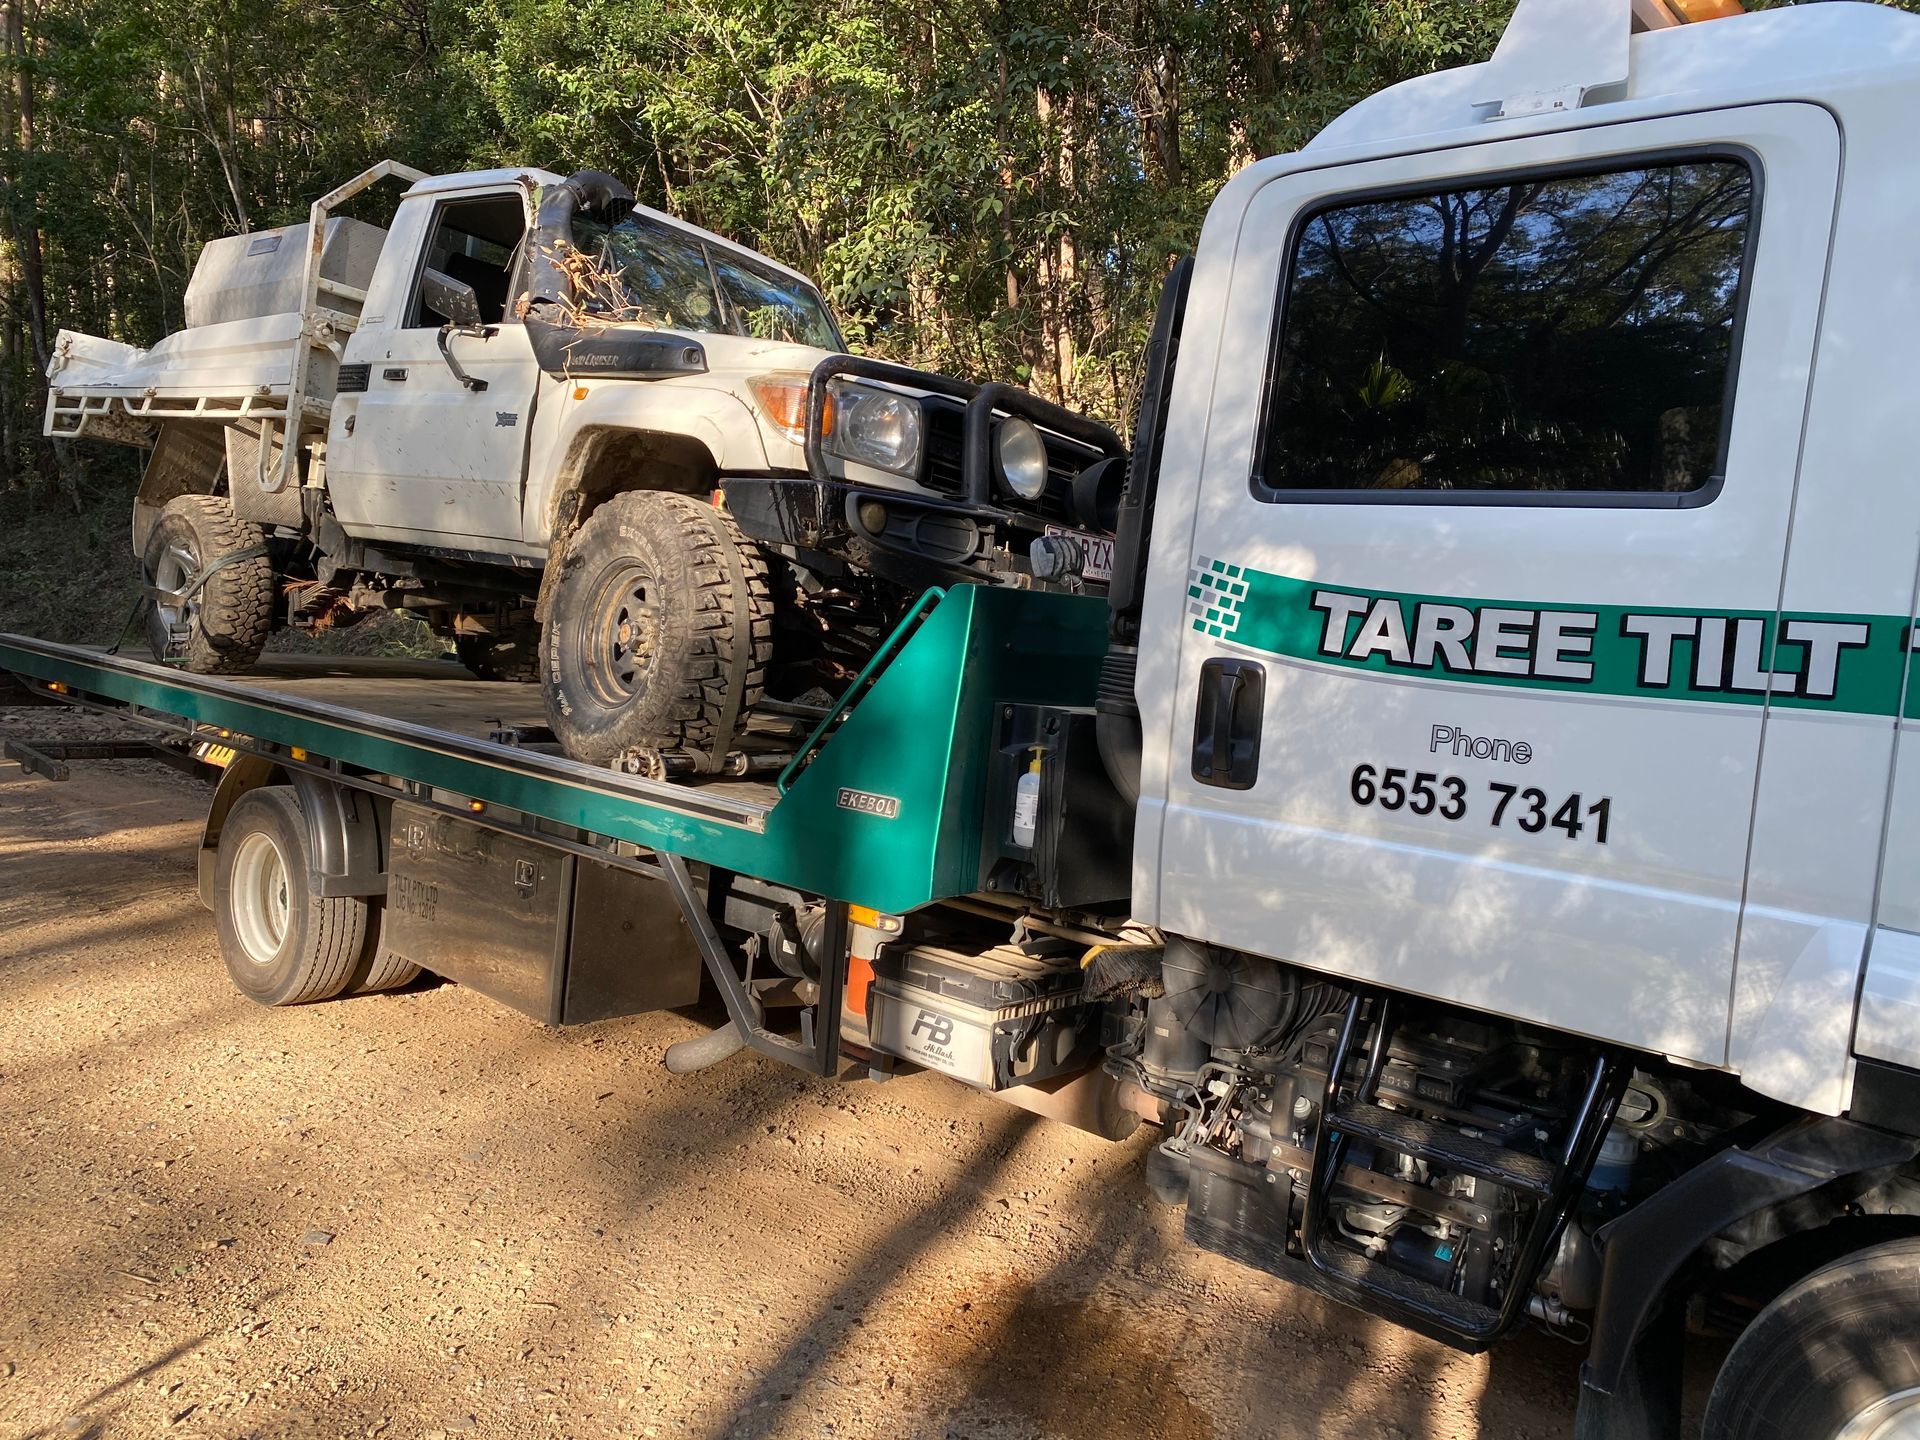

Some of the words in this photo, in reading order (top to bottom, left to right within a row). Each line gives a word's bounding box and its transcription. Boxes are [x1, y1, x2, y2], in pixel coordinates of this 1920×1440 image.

[551, 620, 561, 684] CEPEK
[1310, 590, 1598, 682] TAREE
[1620, 614, 1870, 699] TILT
[1430, 724, 1532, 764] Phone
[840, 791, 892, 815] EKEBOL
[1351, 763, 1467, 821] 6553
[1489, 782, 1612, 844] 7341
[413, 880, 425, 899] PTY
[426, 885, 438, 905] LTD
[911, 1009, 954, 1046] FB
